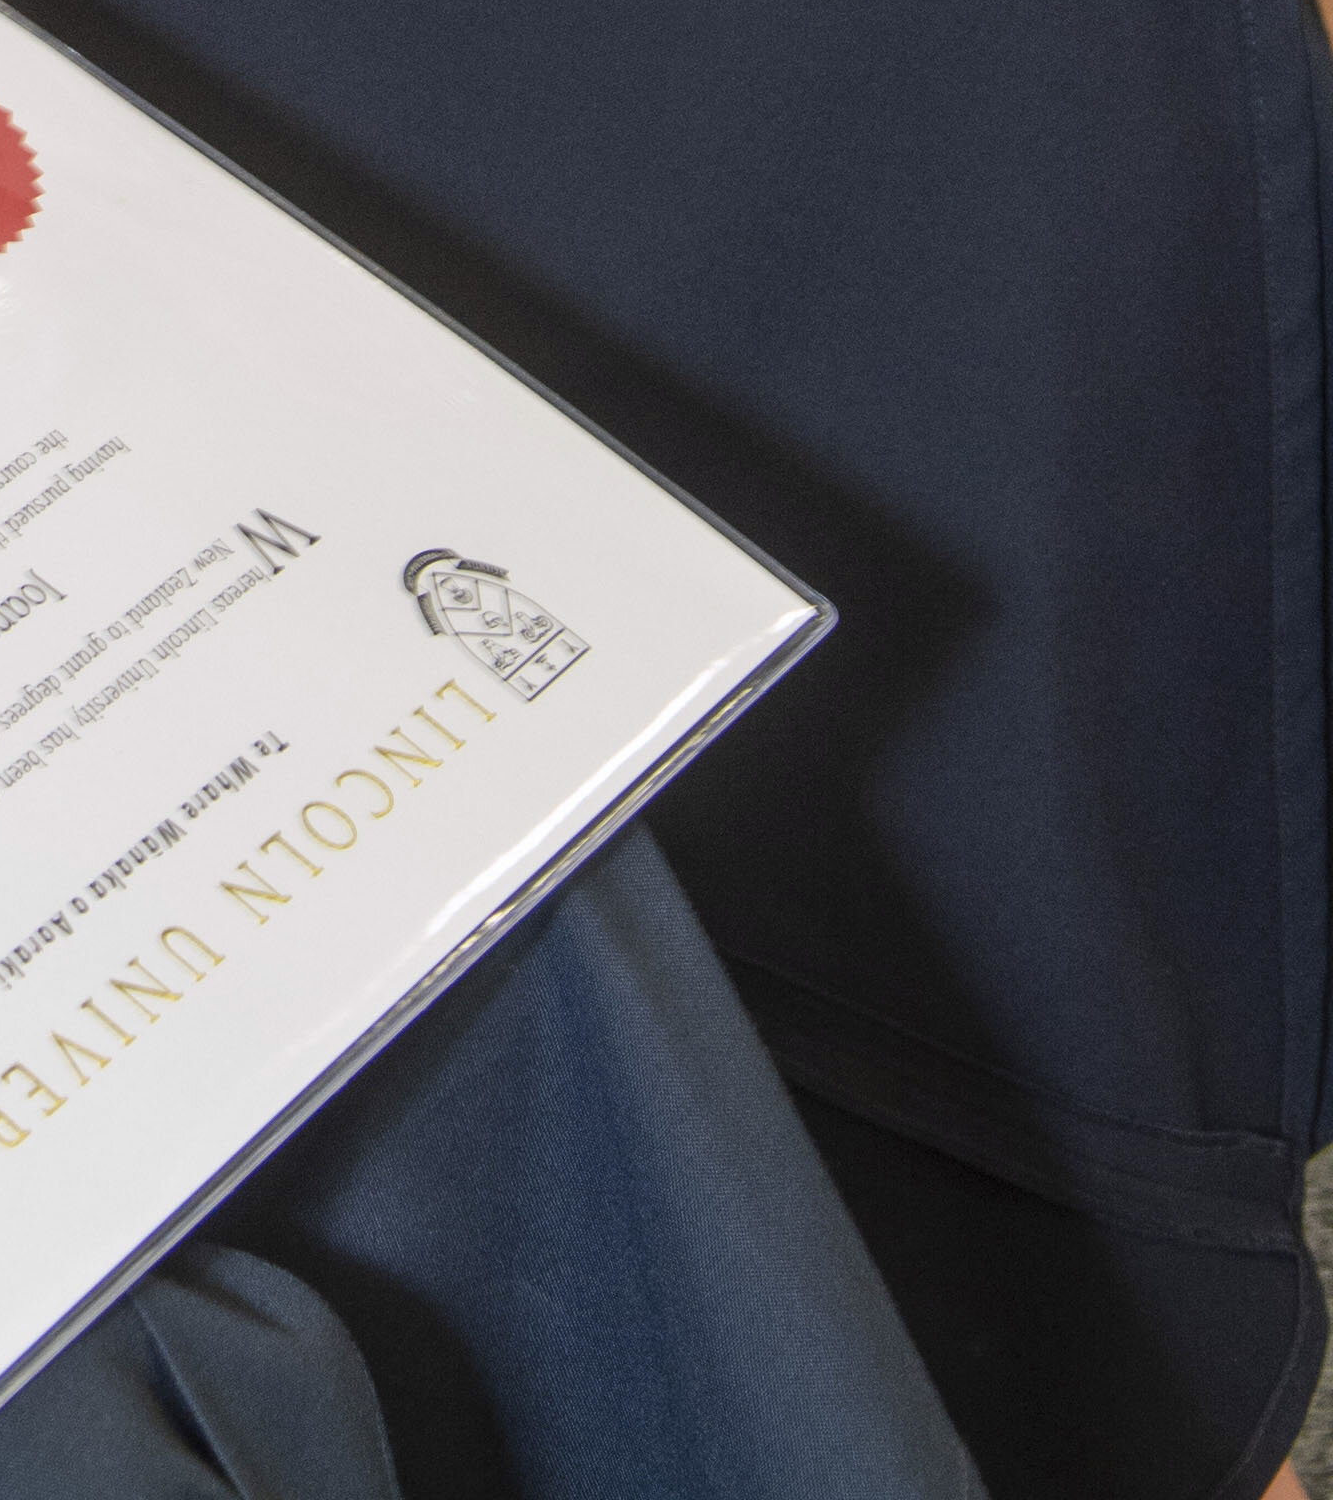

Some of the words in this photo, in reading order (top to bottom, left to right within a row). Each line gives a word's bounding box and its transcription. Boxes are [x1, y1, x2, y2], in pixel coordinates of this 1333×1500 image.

[33, 429, 69, 455] the
[63, 436, 131, 483] having
[1, 474, 72, 537] pursued
[192, 538, 235, 572] New
[210, 508, 321, 612] Whereas
[123, 567, 198, 629] Zealand
[58, 632, 108, 680] grant
[104, 620, 131, 641] to
[150, 607, 219, 661] Lincoln
[71, 658, 160, 727] University
[38, 723, 81, 754] has
[252, 731, 289, 757] Te
[180, 756, 259, 820] Whare
[219, 679, 497, 926] LINCOLN
[88, 819, 187, 899] Wānaka
[69, 897, 89, 915] o
